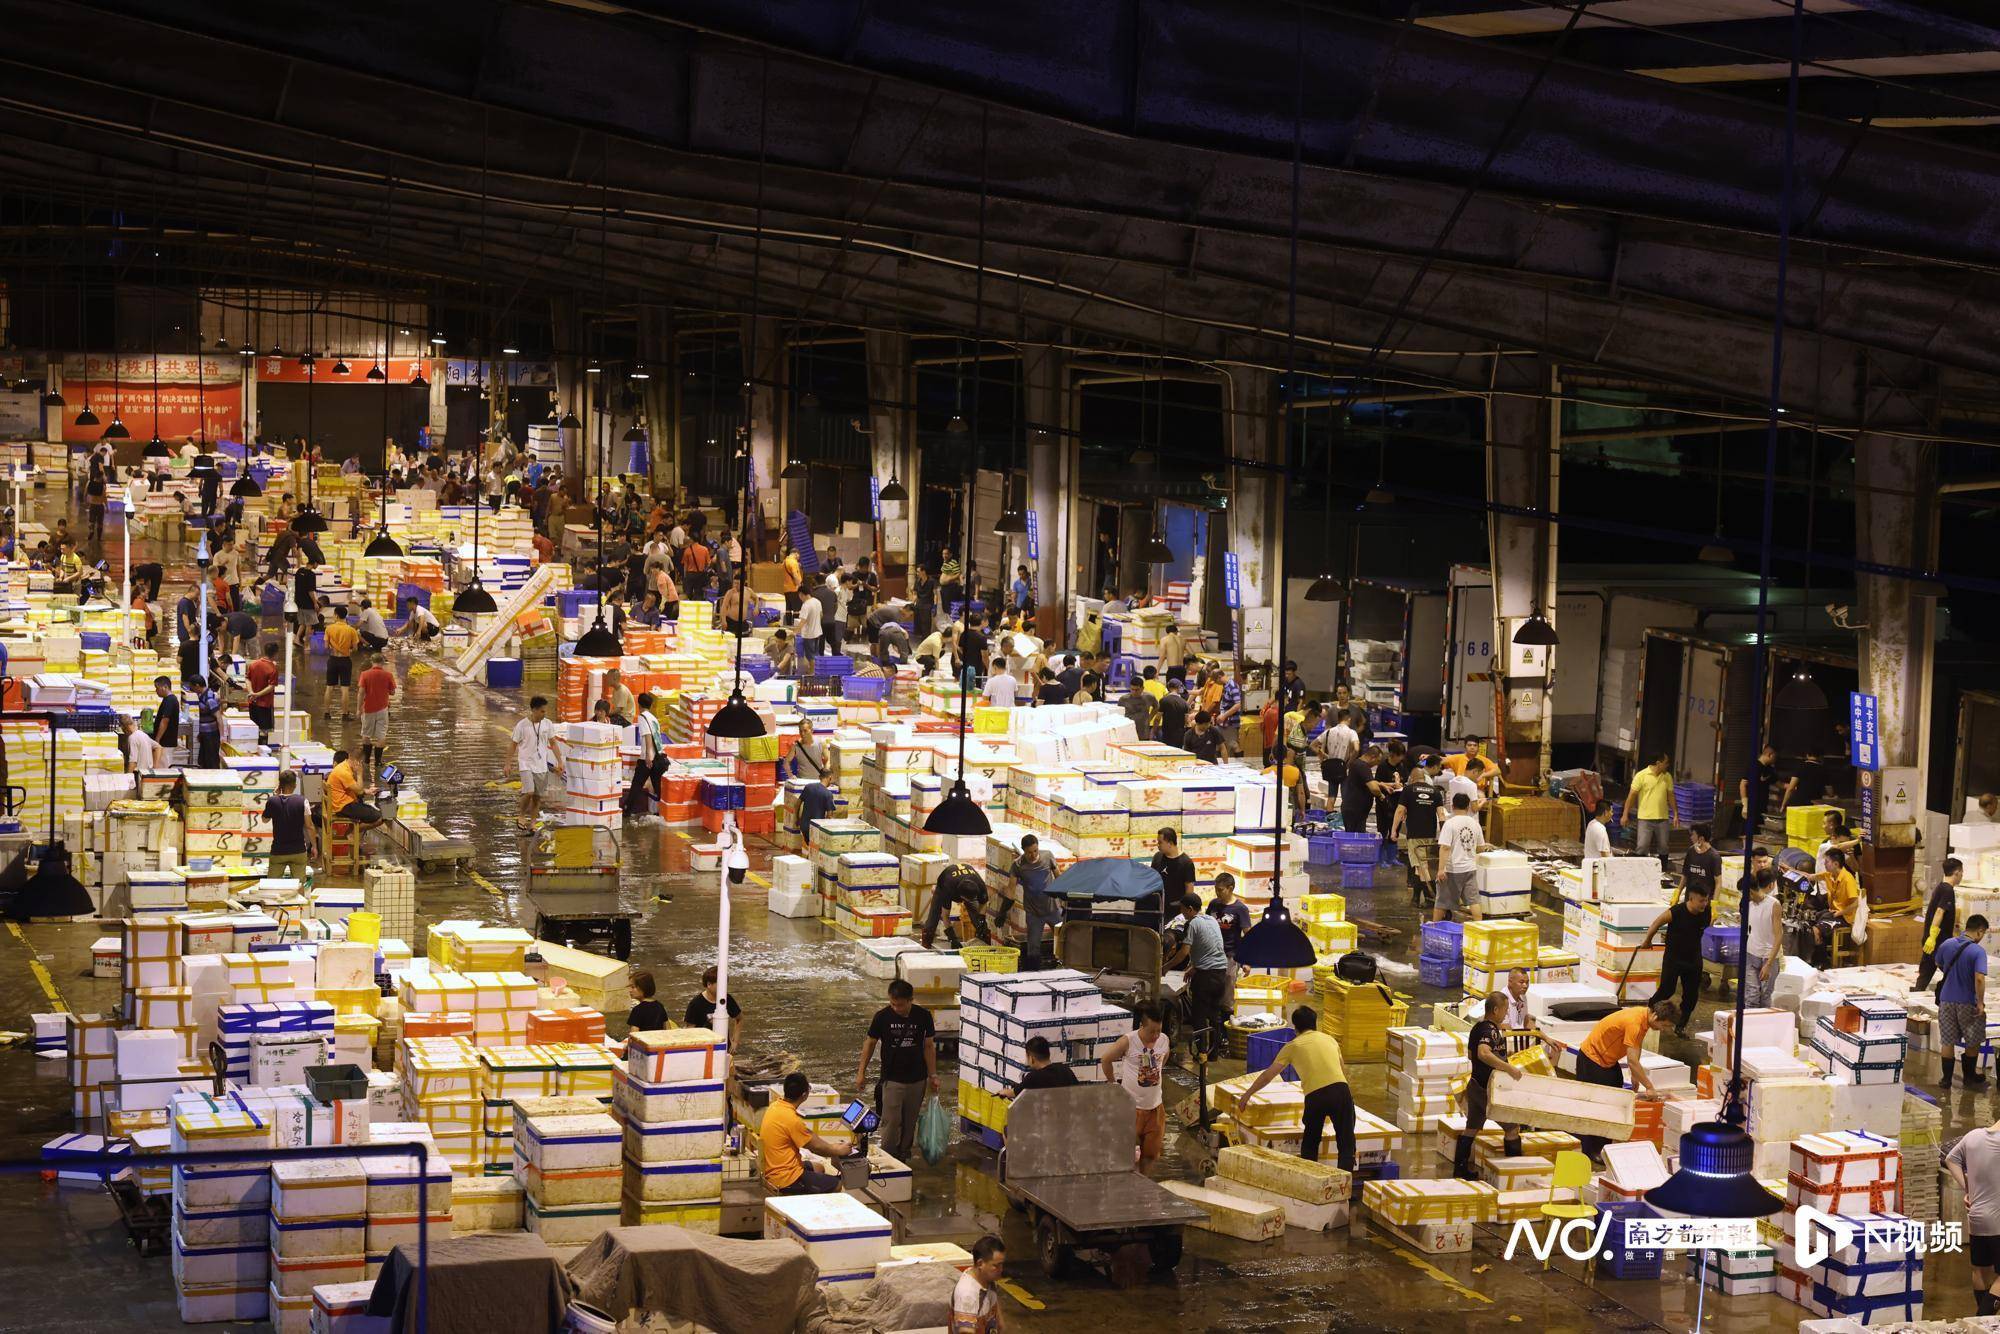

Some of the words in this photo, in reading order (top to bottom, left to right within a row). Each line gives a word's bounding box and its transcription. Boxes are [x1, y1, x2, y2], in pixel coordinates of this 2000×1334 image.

[1854, 694, 1862, 742] 集中结算
[1866, 697, 1874, 744] 刷卡交易
